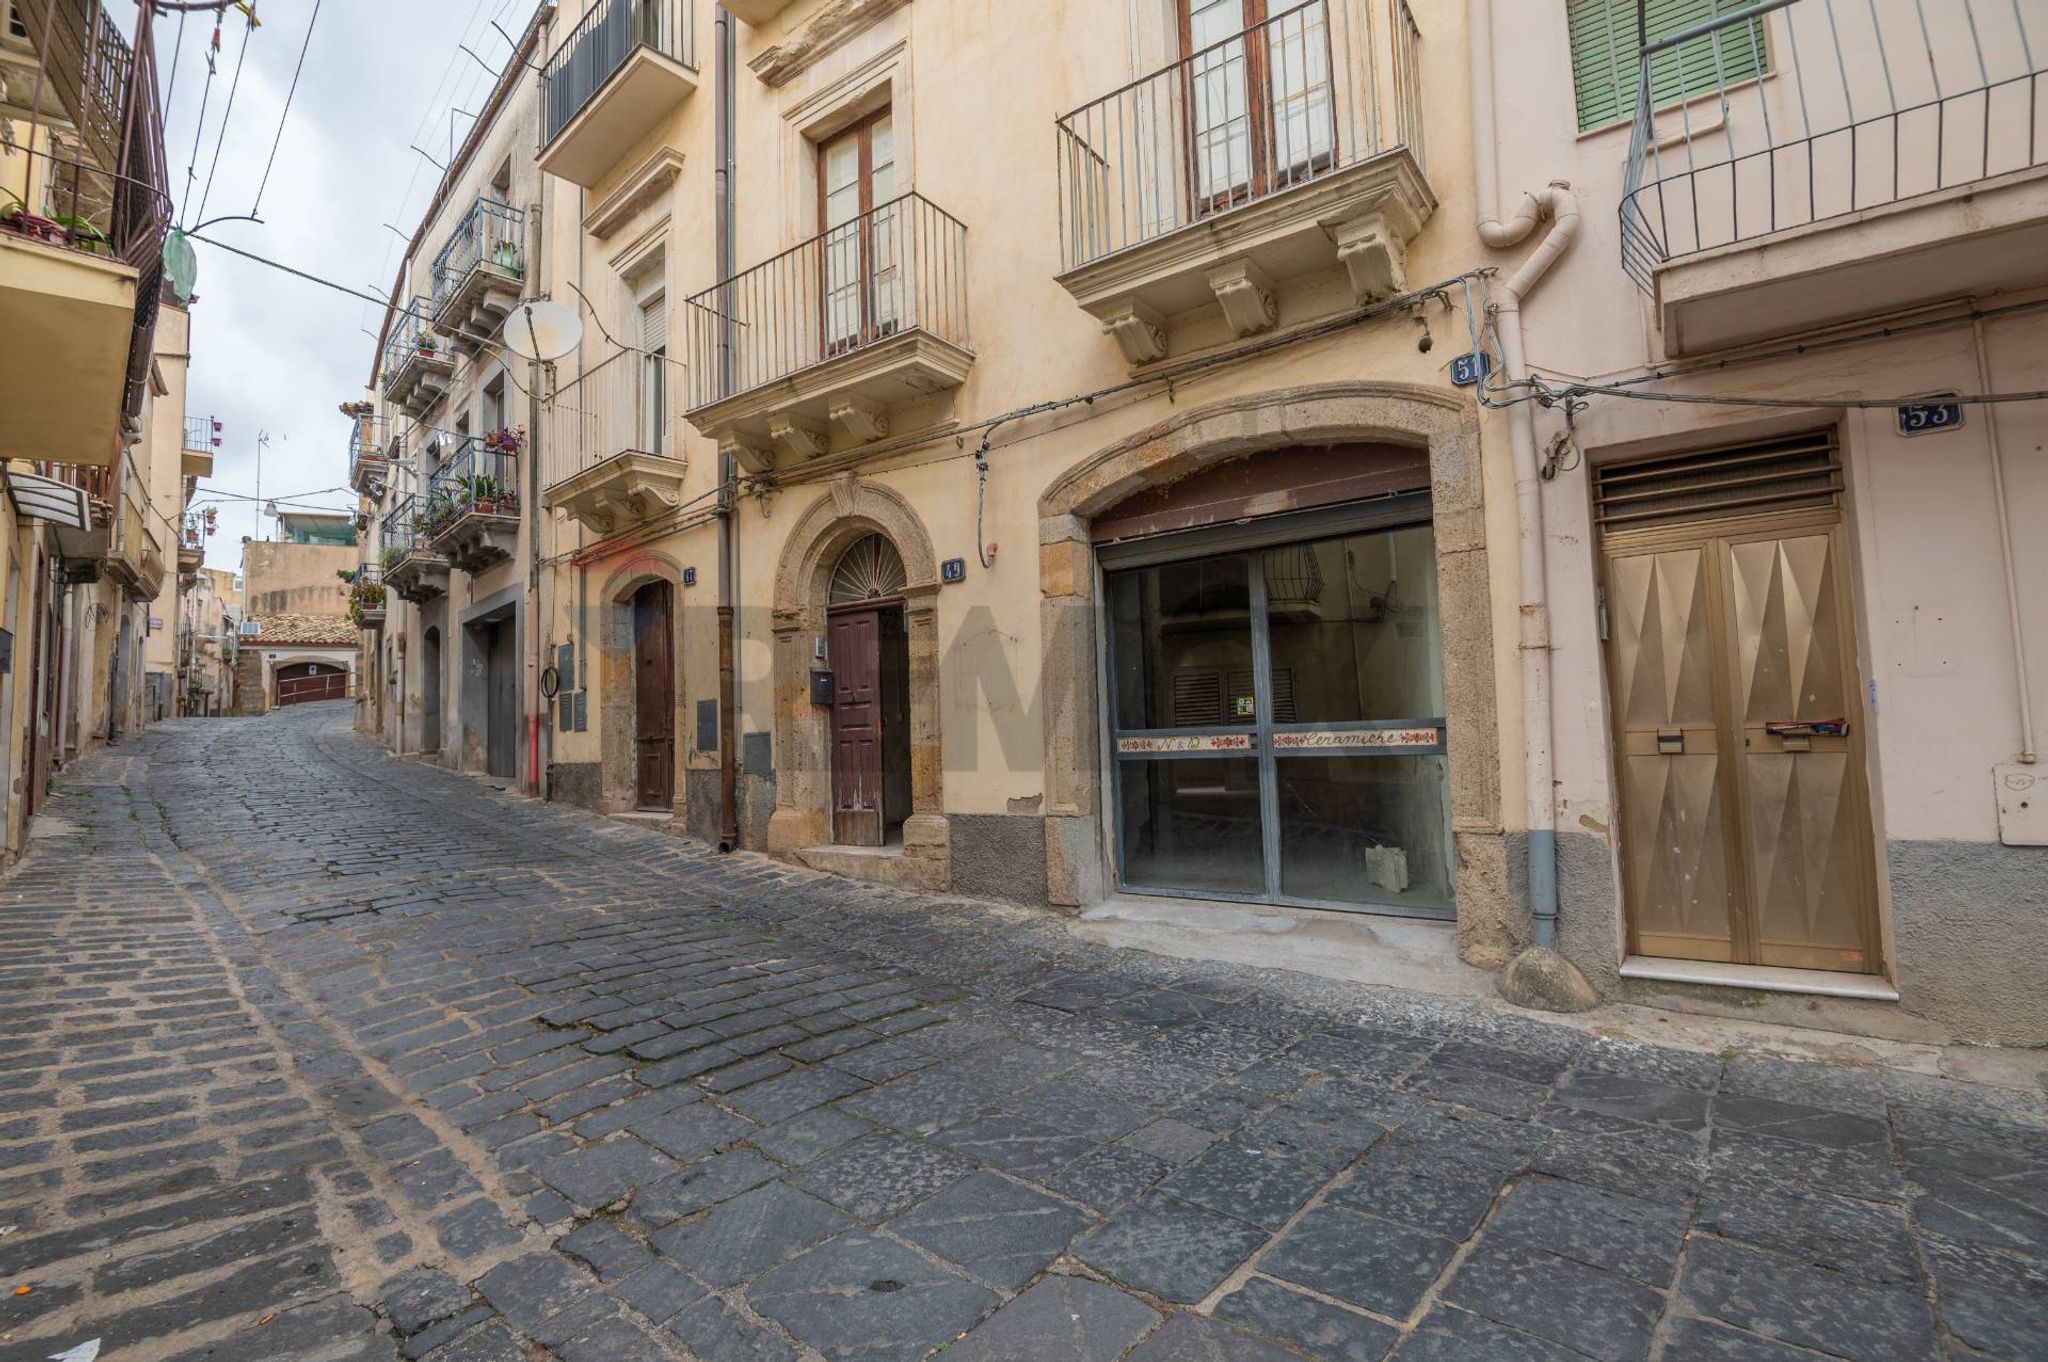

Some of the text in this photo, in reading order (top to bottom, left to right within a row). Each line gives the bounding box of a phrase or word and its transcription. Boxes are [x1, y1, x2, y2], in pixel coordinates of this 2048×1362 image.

[1457, 358, 1481, 379] 51
[945, 561, 960, 578] 49
[1303, 730, 1397, 746] Ceramiche
